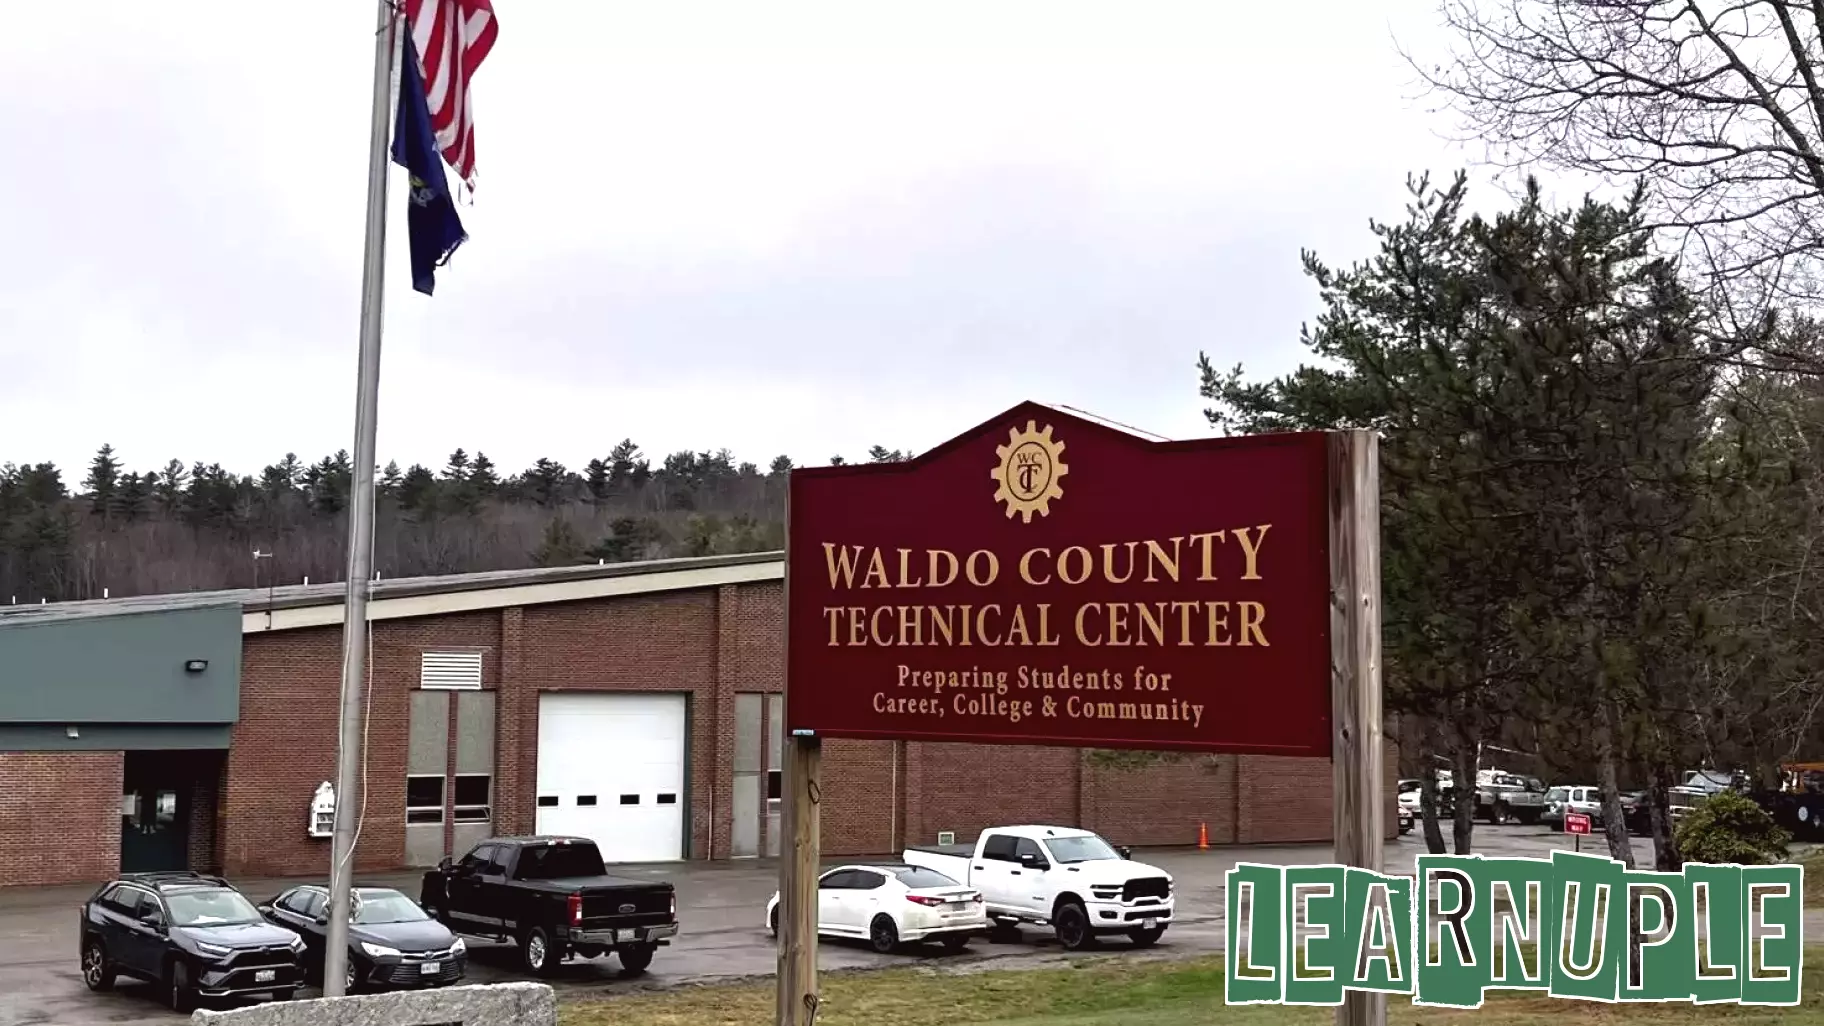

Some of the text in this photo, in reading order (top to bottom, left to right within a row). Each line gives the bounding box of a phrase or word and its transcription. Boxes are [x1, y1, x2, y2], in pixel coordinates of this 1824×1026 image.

[1016, 452, 1042, 464] WC
[822, 524, 1273, 590] WALDO COUNTY
[823, 601, 1270, 647] TECHNICAL CENTER
[897, 665, 1172, 695] Preparing Students for
[873, 692, 1204, 728] Career, College & Community
